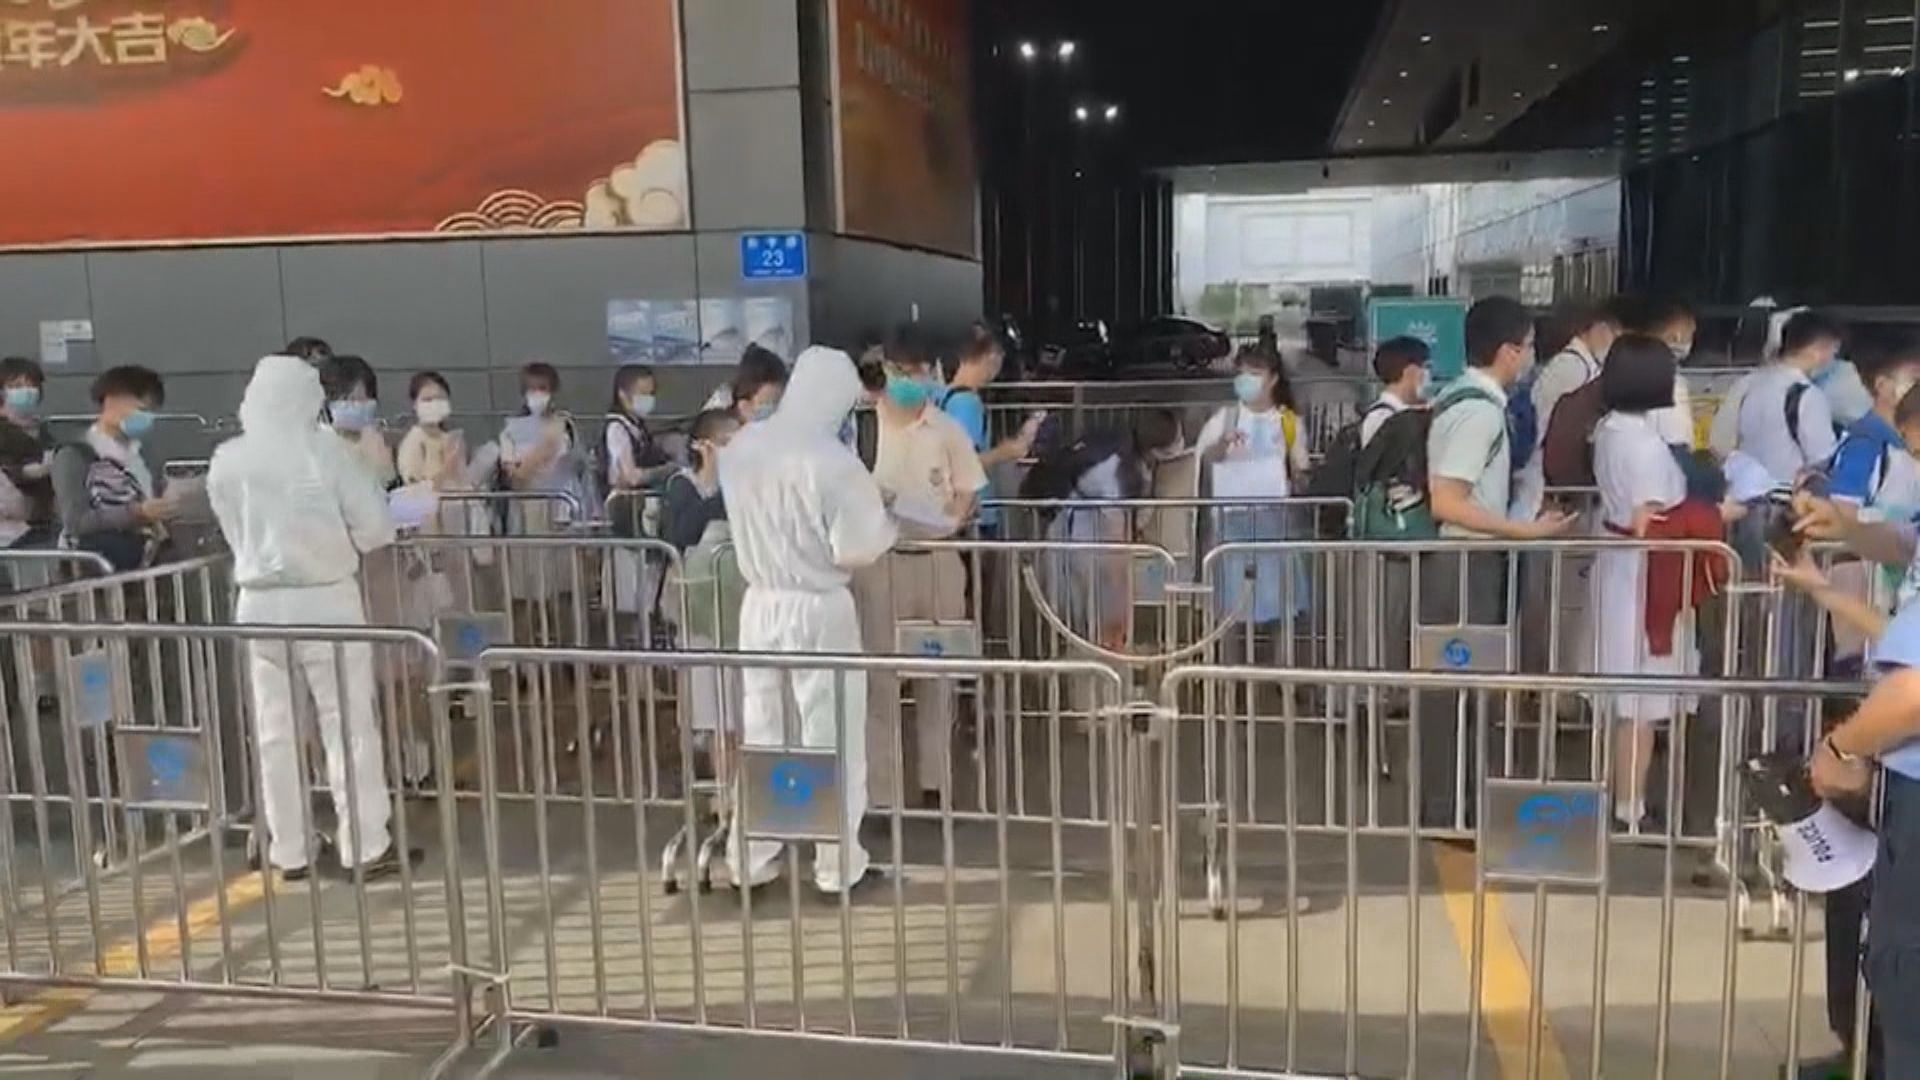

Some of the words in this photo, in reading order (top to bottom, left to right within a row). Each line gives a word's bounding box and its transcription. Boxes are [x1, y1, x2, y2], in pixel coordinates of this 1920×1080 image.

[0, 12, 167, 69] 年大吉
[762, 248, 785, 268] 23
[1797, 820, 1834, 864] POLICE
